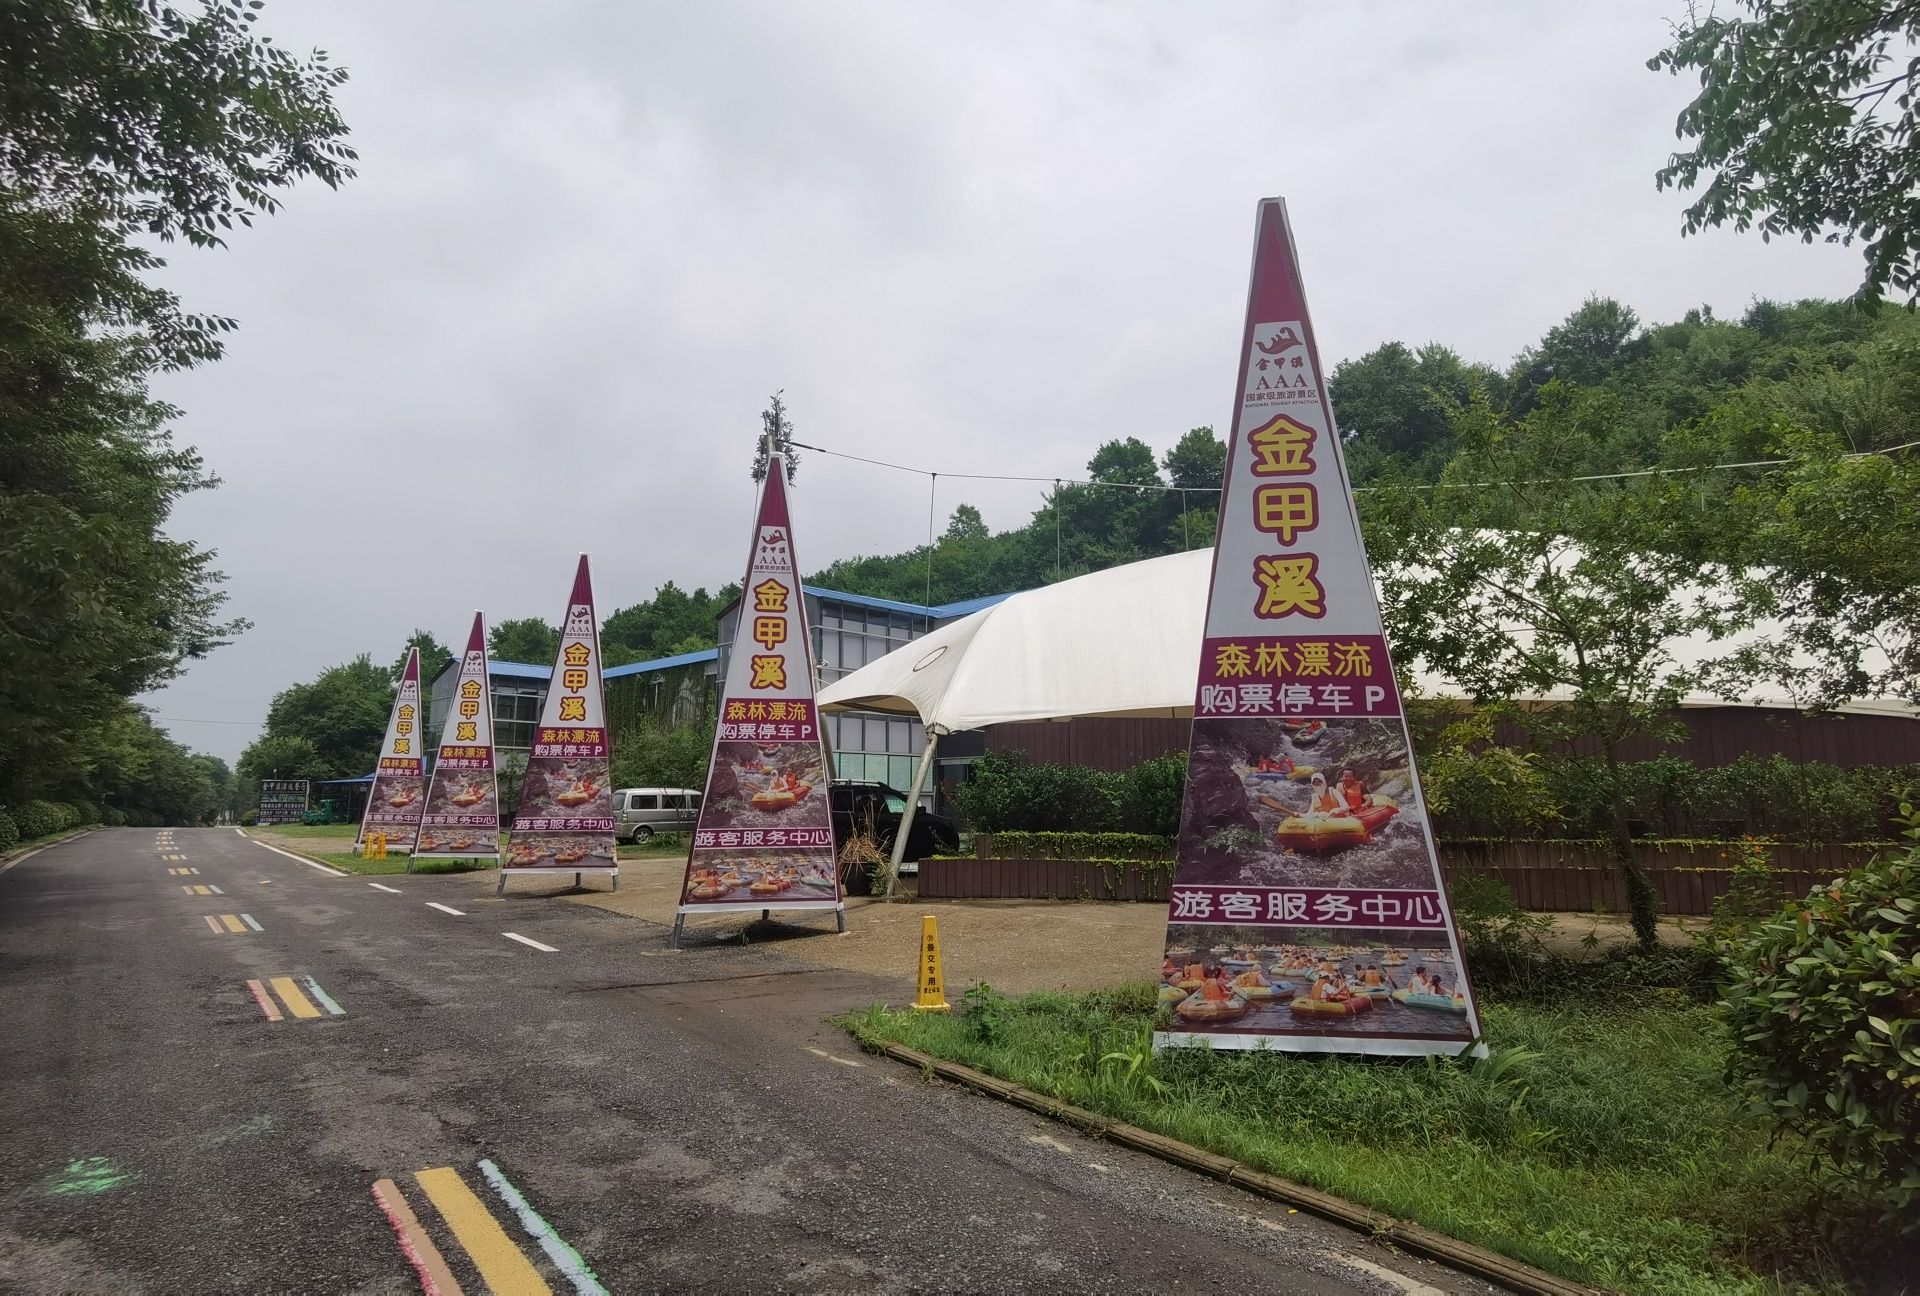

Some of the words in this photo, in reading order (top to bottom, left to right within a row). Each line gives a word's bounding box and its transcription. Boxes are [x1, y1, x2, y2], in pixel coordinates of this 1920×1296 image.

[1256, 372, 1308, 390] AAA
[1246, 390, 1317, 402] 国家级旅游景区
[1247, 413, 1327, 619] 金甲溪
[759, 555, 787, 565] AAA
[750, 577, 790, 690] 金甲溪
[1215, 641, 1372, 678] 森林漂流
[559, 642, 591, 721] 金甲溪
[1200, 682, 1354, 714] 购票停车
[1365, 685, 1385, 712] P
[456, 680, 482, 741] 金甲溪
[727, 701, 807, 721] 森林漂流
[393, 704, 414, 754] 金甲溪
[542, 729, 600, 743] 森林漂流
[720, 723, 795, 740] 购票停车
[801, 726, 812, 738] P
[442, 747, 487, 758] 森林漂流
[534, 744, 591, 756] 购票停车
[594, 745, 603, 755] P
[482, 759, 489, 768] P
[515, 819, 613, 830] 游客服务中心
[694, 830, 832, 846] 游客服务中心
[1172, 890, 1446, 924] 游客服务中心
